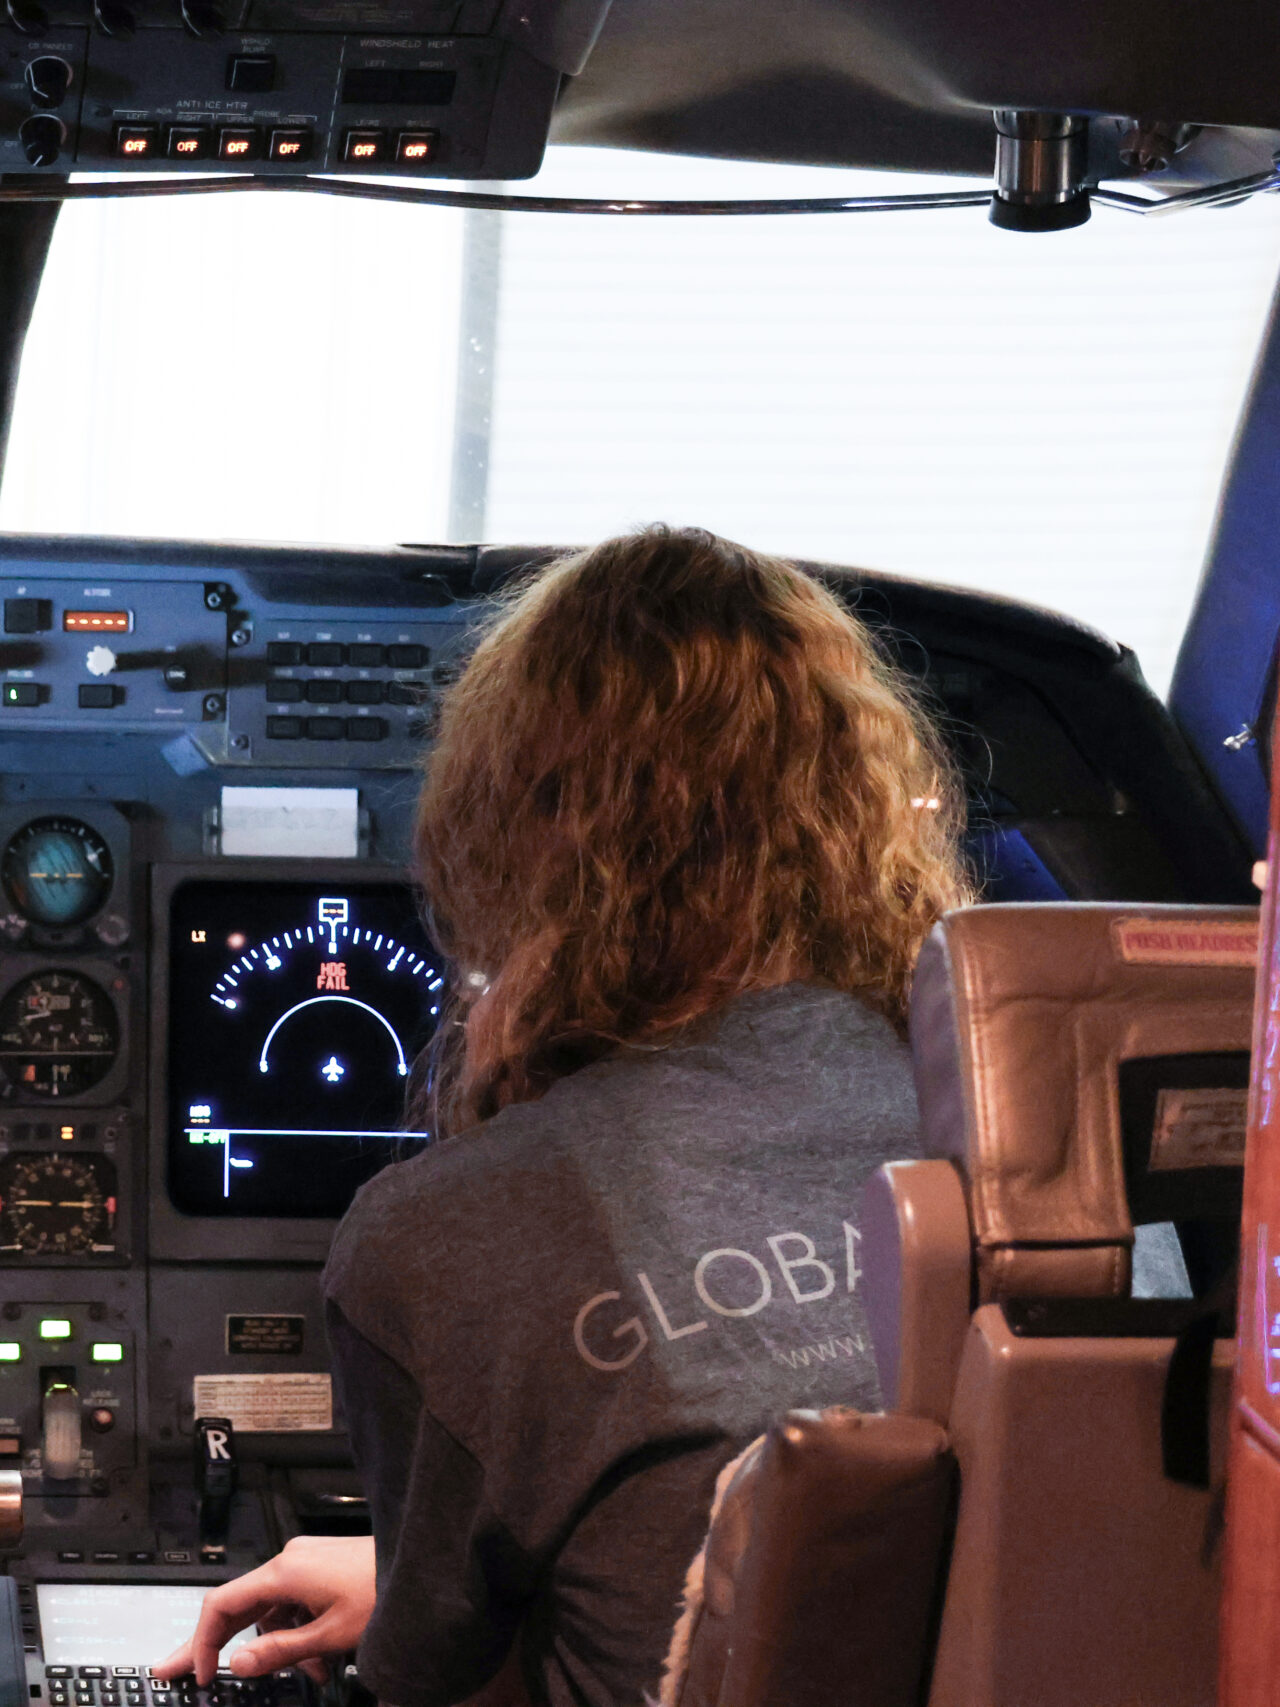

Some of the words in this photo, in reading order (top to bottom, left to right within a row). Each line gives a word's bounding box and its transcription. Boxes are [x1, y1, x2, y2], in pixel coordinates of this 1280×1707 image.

[360, 39, 422, 48] WINDSHIELD
[427, 40, 456, 49] HEAT
[176, 100, 201, 109] ANTI
[204, 101, 222, 110] ICE
[124, 140, 147, 153] OFF
[176, 141, 199, 153] OFF
[227, 141, 250, 154] OFF
[279, 143, 301, 155] OFF
[354, 144, 376, 156] OFF
[405, 144, 428, 156] OFF
[320, 962, 347, 977] HDG
[317, 975, 350, 990] FAIL
[206, 1429, 231, 1460] R
